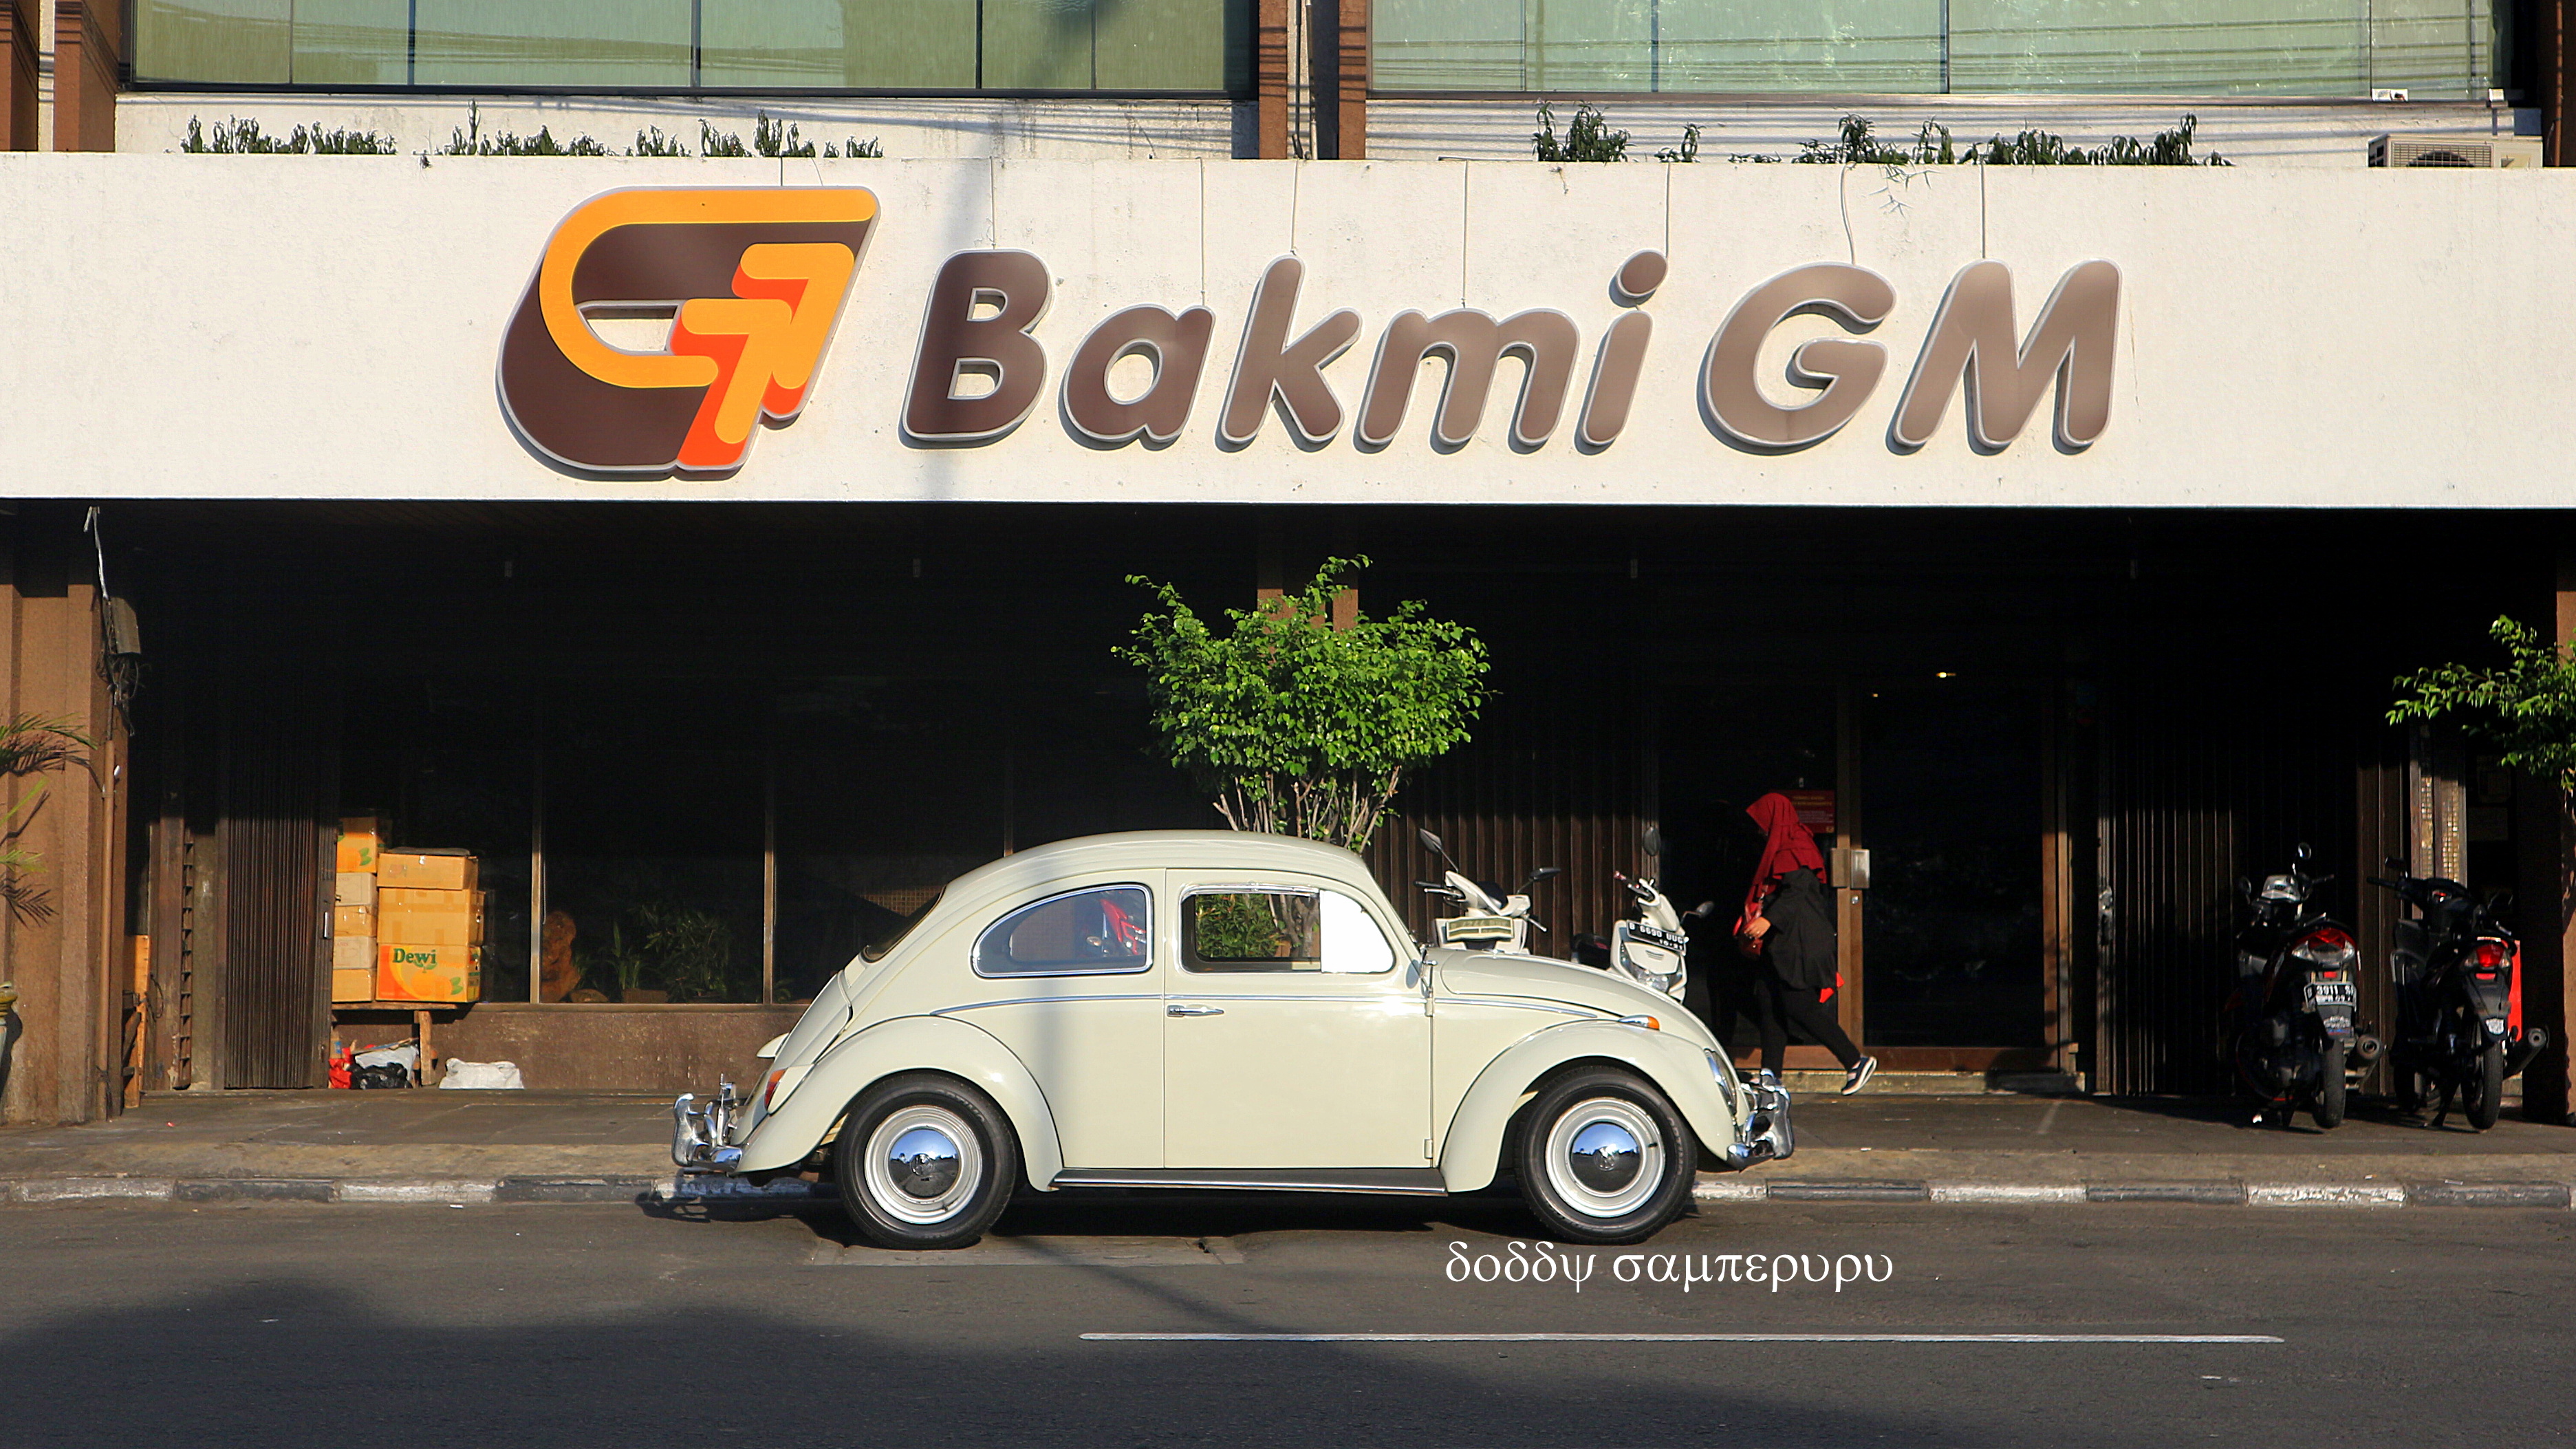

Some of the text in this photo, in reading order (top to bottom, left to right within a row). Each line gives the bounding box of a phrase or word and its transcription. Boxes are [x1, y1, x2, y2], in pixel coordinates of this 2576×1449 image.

[902, 250, 2123, 448] Bakmi GM
[392, 948, 437, 964] Dewi
